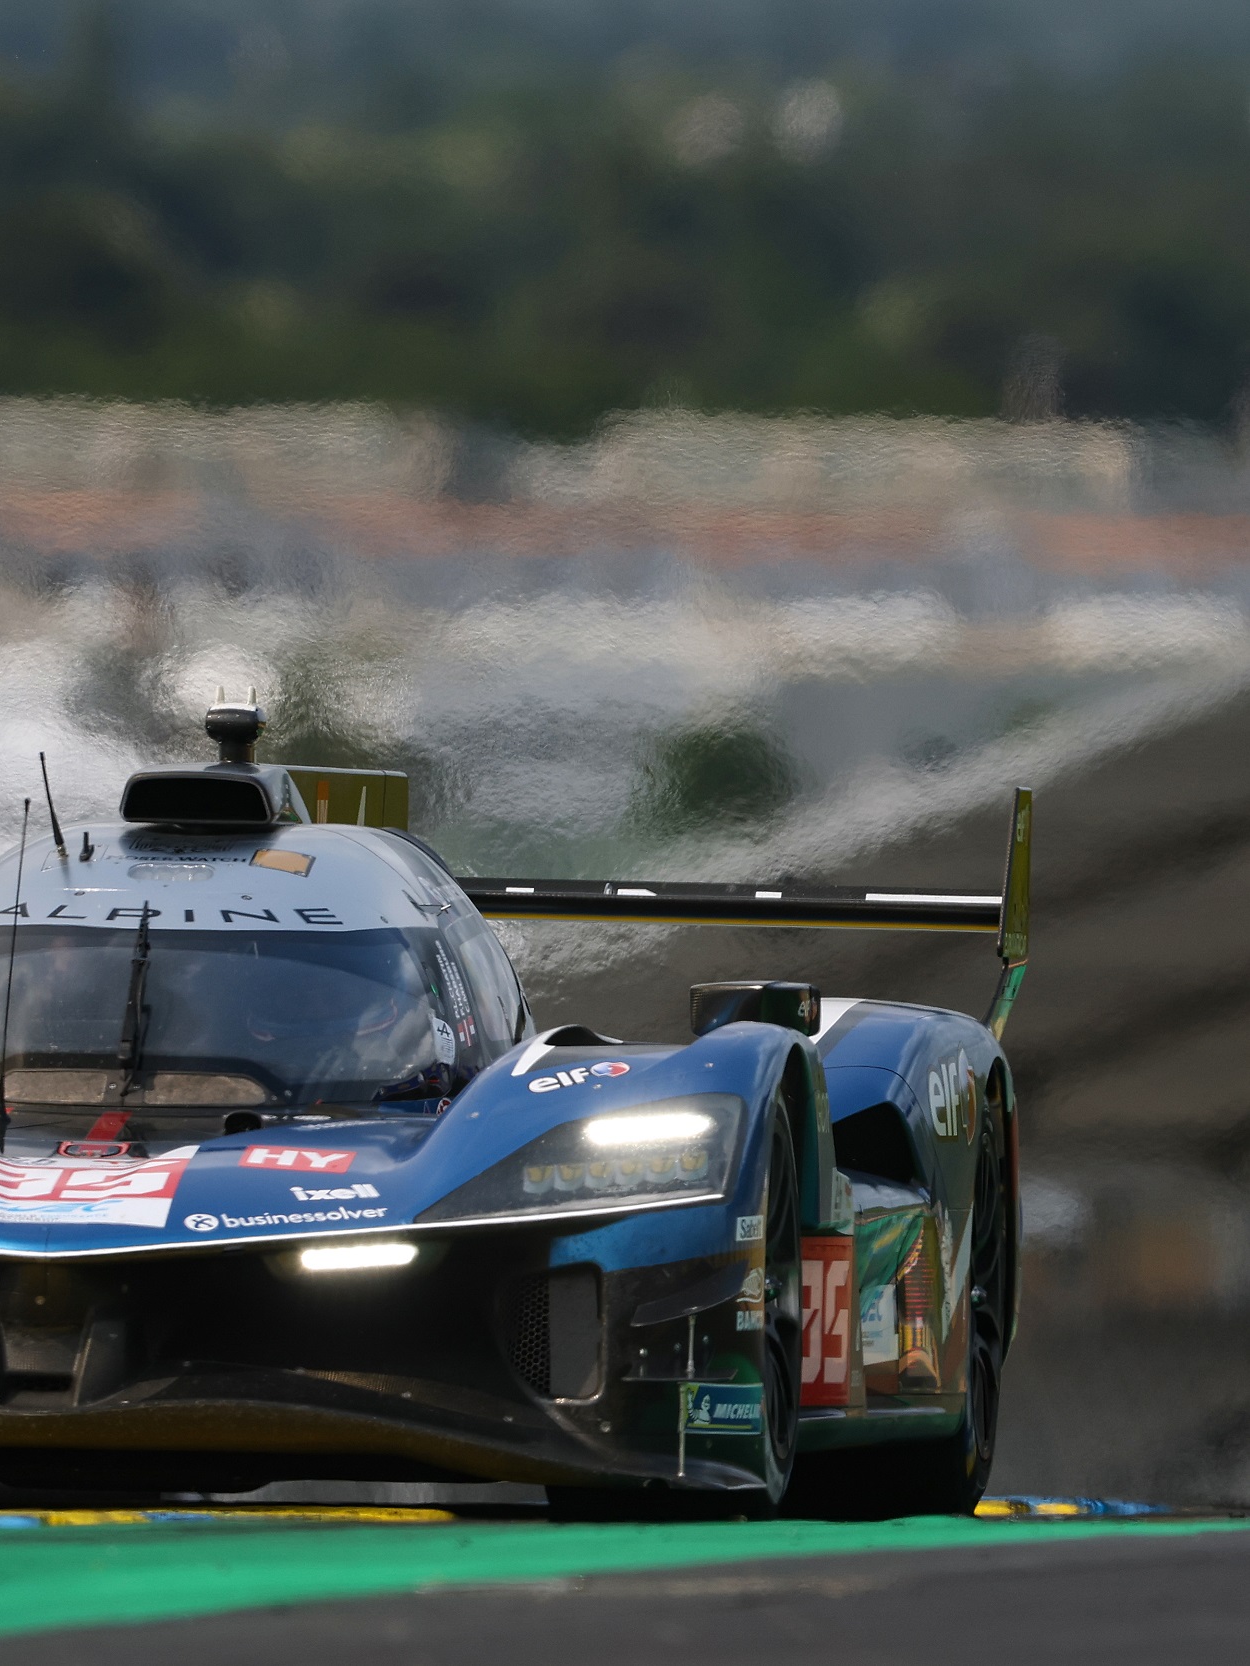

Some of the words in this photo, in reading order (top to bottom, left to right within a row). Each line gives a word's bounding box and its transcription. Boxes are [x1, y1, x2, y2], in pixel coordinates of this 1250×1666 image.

[528, 1067, 589, 1093] elf
[928, 1062, 959, 1137] elf
[290, 1183, 380, 1202] ixell
[221, 1206, 389, 1229] businessolver
